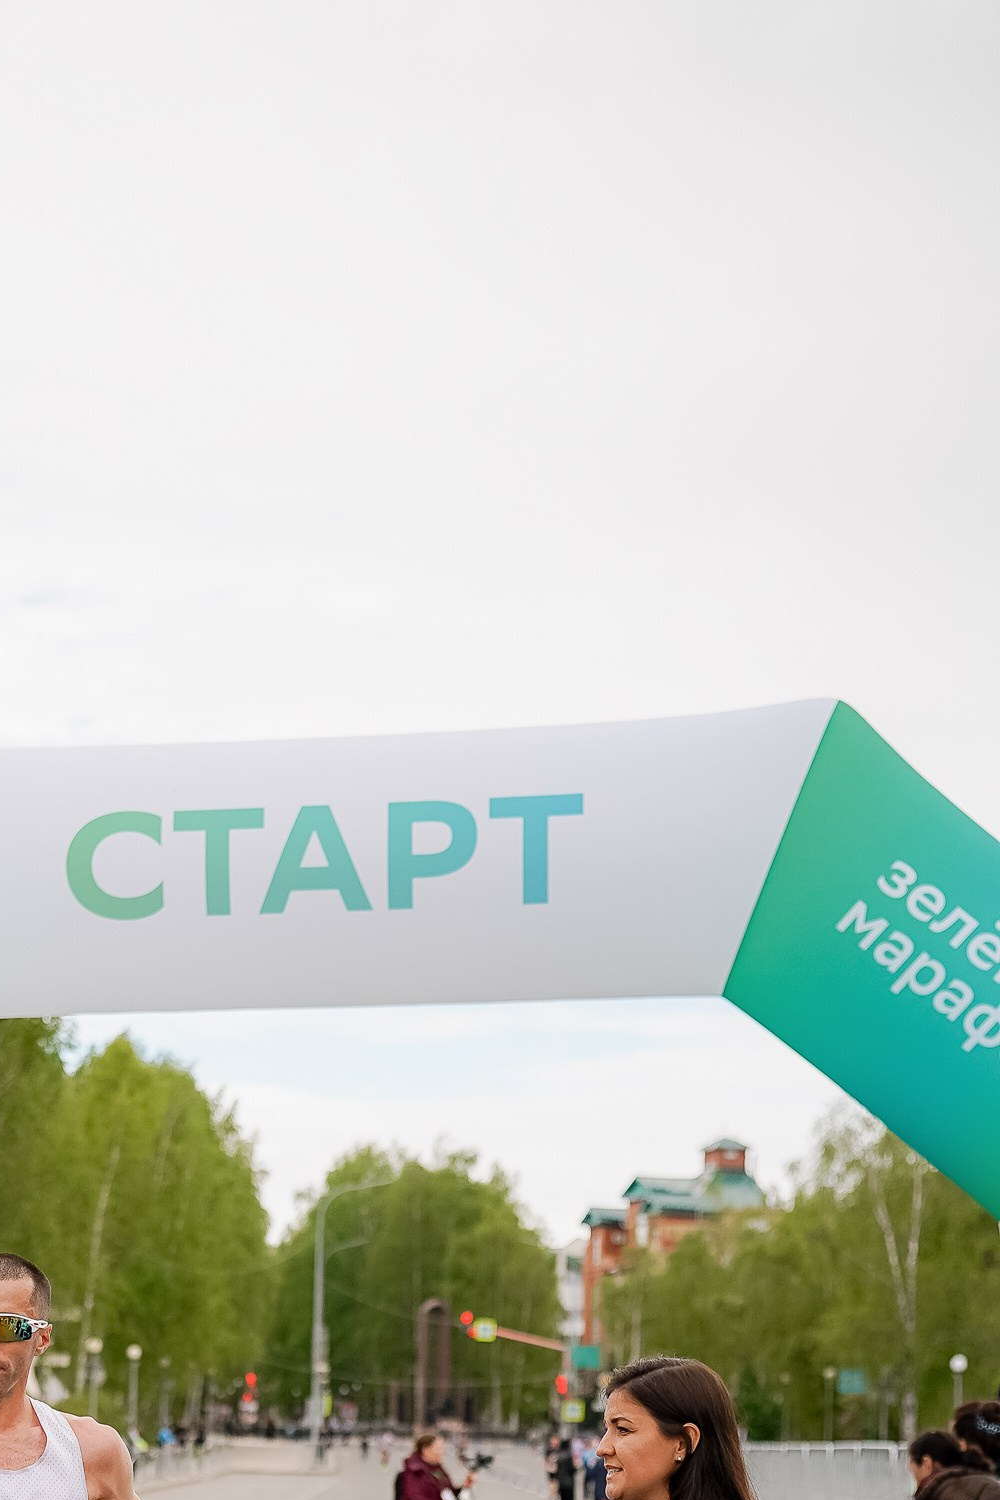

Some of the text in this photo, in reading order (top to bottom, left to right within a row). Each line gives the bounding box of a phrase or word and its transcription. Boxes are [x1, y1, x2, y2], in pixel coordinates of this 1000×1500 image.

[66, 793, 584, 921] СТАРТ
[835, 899, 1000, 1053] мараф
[876, 859, 1000, 984] зелё
